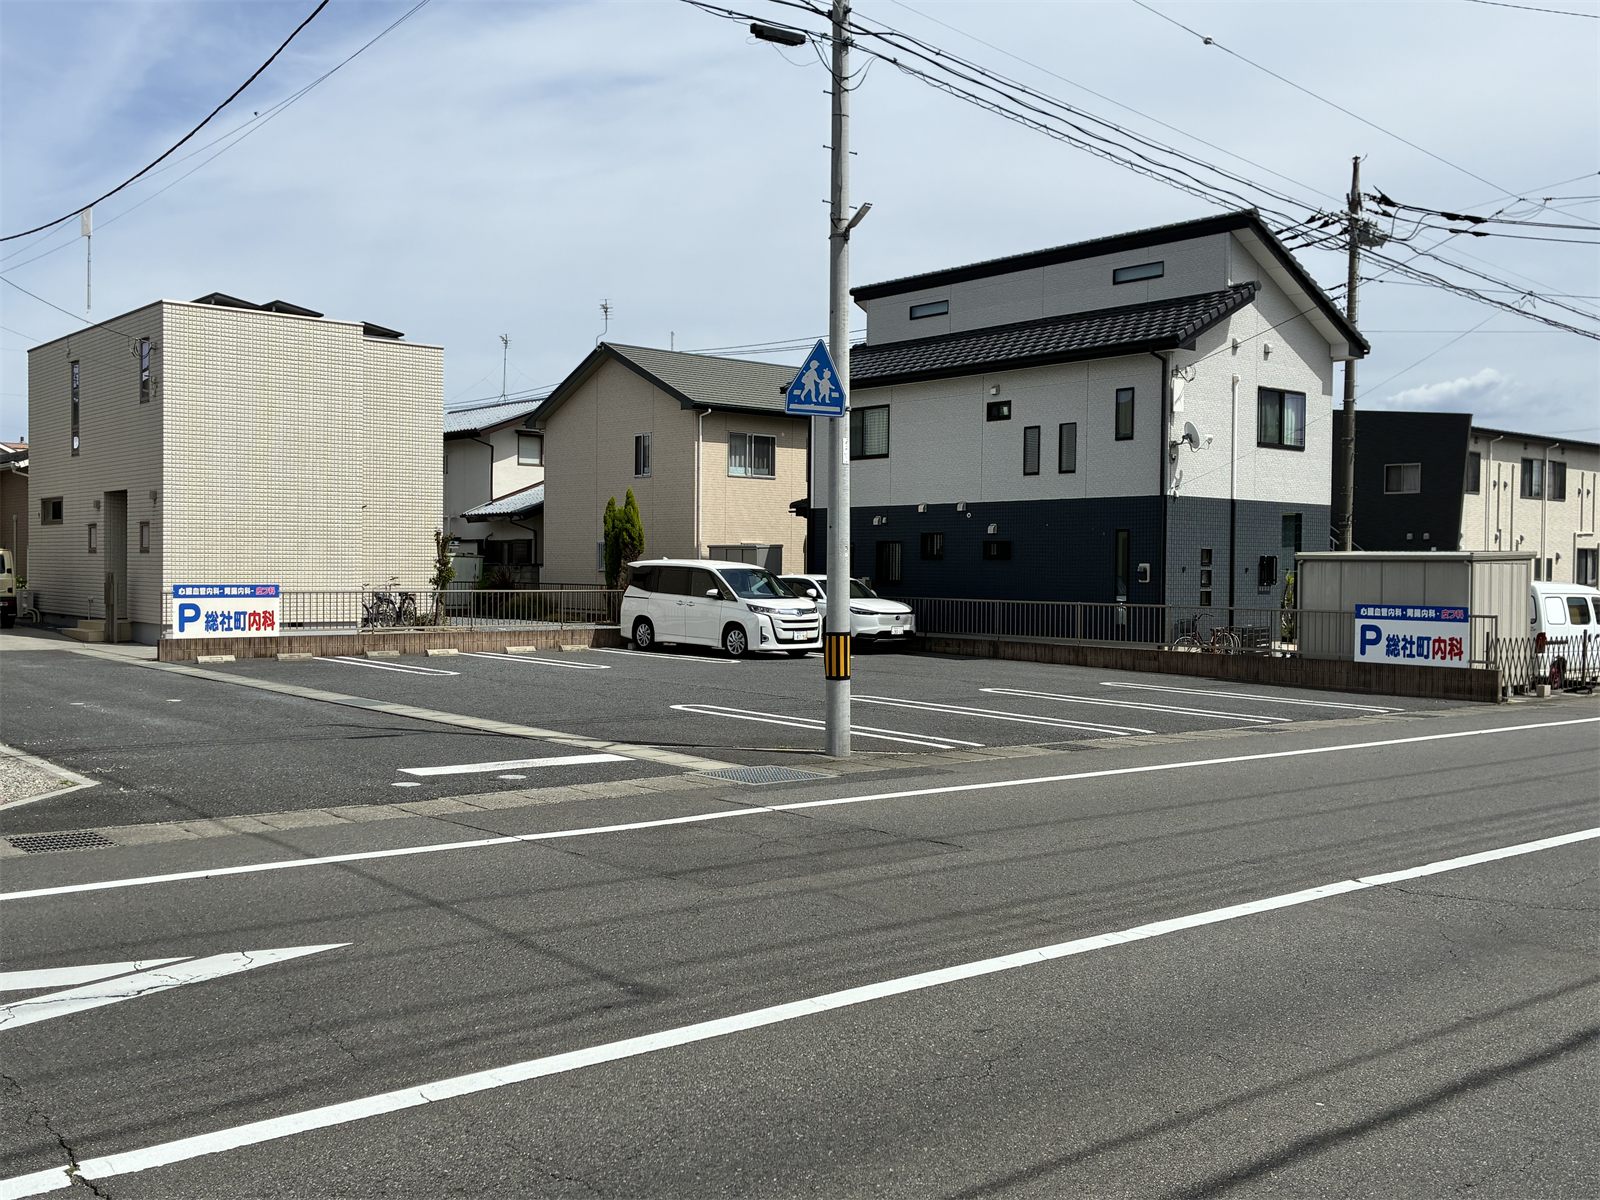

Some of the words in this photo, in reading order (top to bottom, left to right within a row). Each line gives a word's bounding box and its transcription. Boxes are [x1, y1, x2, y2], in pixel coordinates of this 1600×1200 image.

[178, 603, 201, 633] P
[204, 610, 276, 632] 総社町内科
[1360, 624, 1383, 656] P
[1385, 634, 1464, 661] 総社町内科
